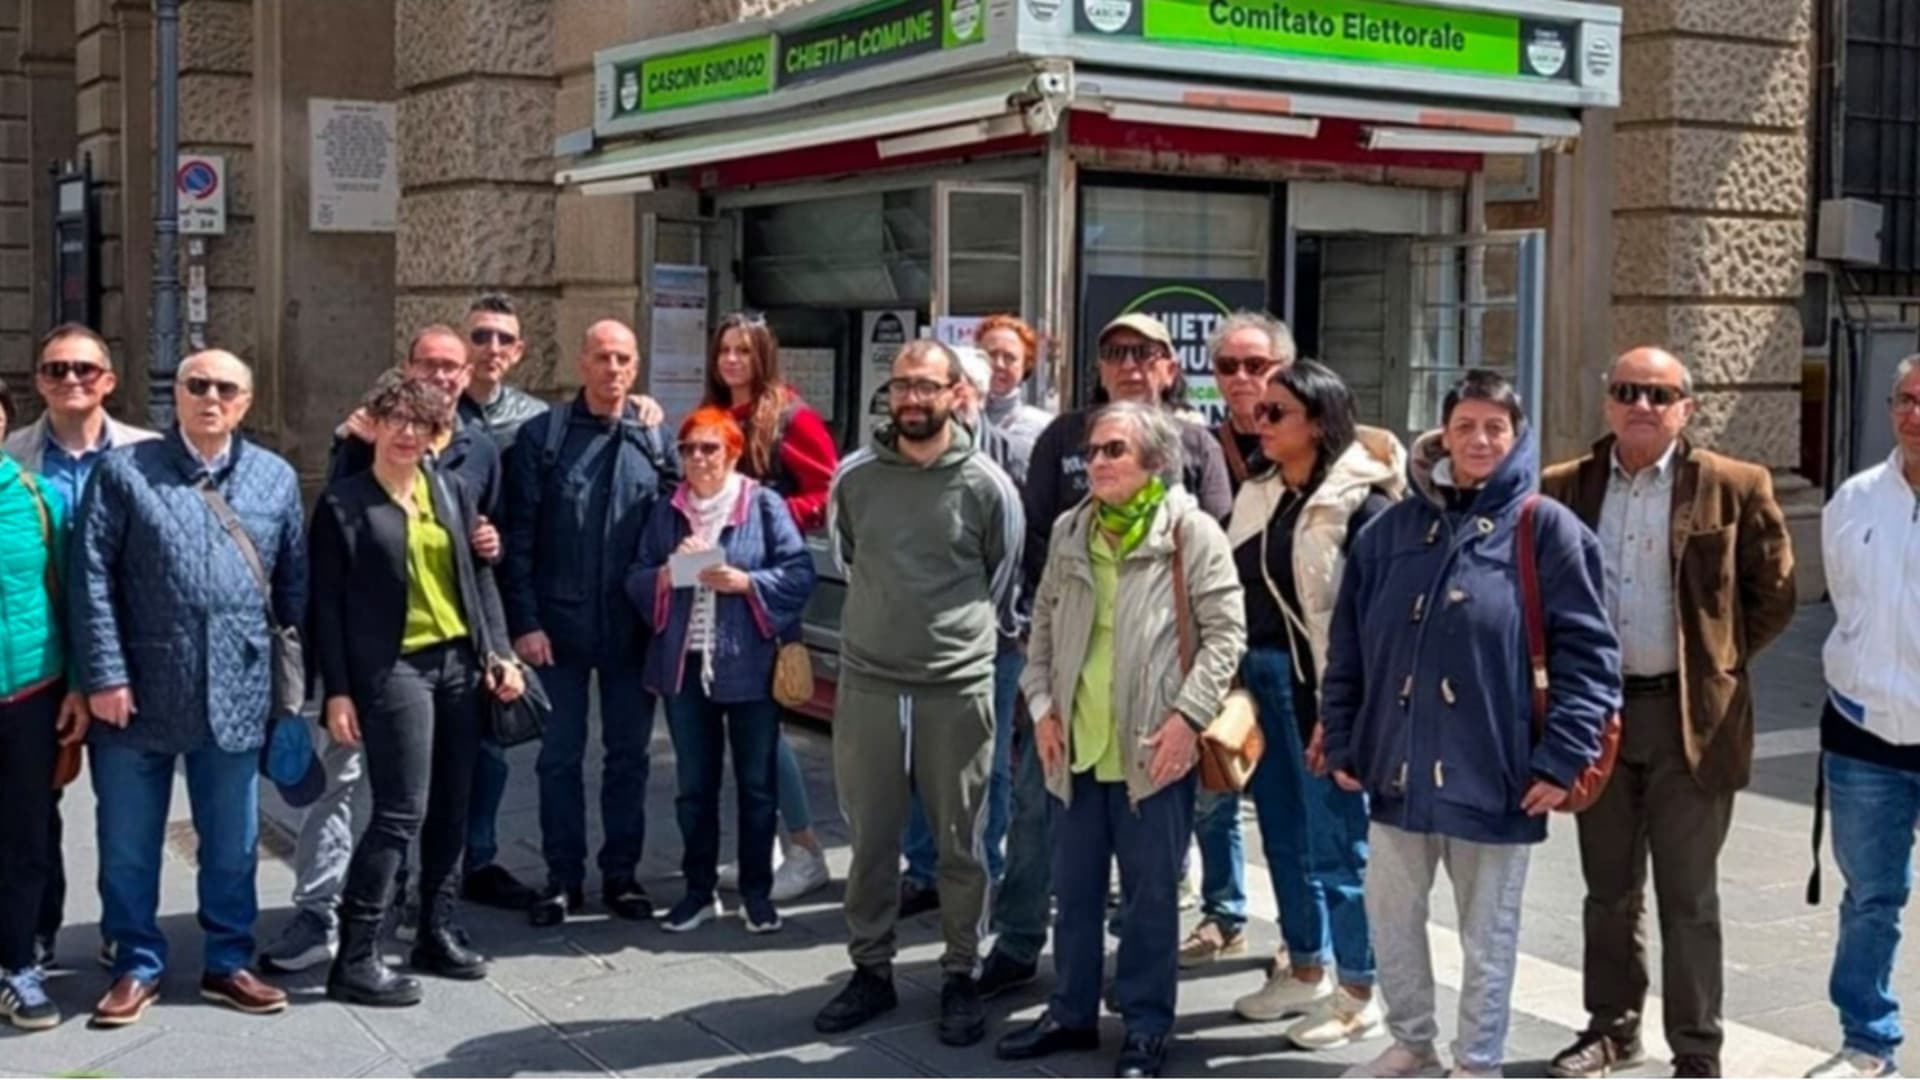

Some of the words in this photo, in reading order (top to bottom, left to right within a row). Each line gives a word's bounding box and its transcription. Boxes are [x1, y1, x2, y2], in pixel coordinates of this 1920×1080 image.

[785, 42, 840, 73] CHIETI
[842, 36, 857, 57] in
[859, 10, 934, 57] COMUNE
[1209, 0, 1336, 38] Comitato
[1342, 13, 1466, 52] Elettorale
[648, 65, 701, 94] CASCINI
[703, 53, 766, 86] SINDACO
